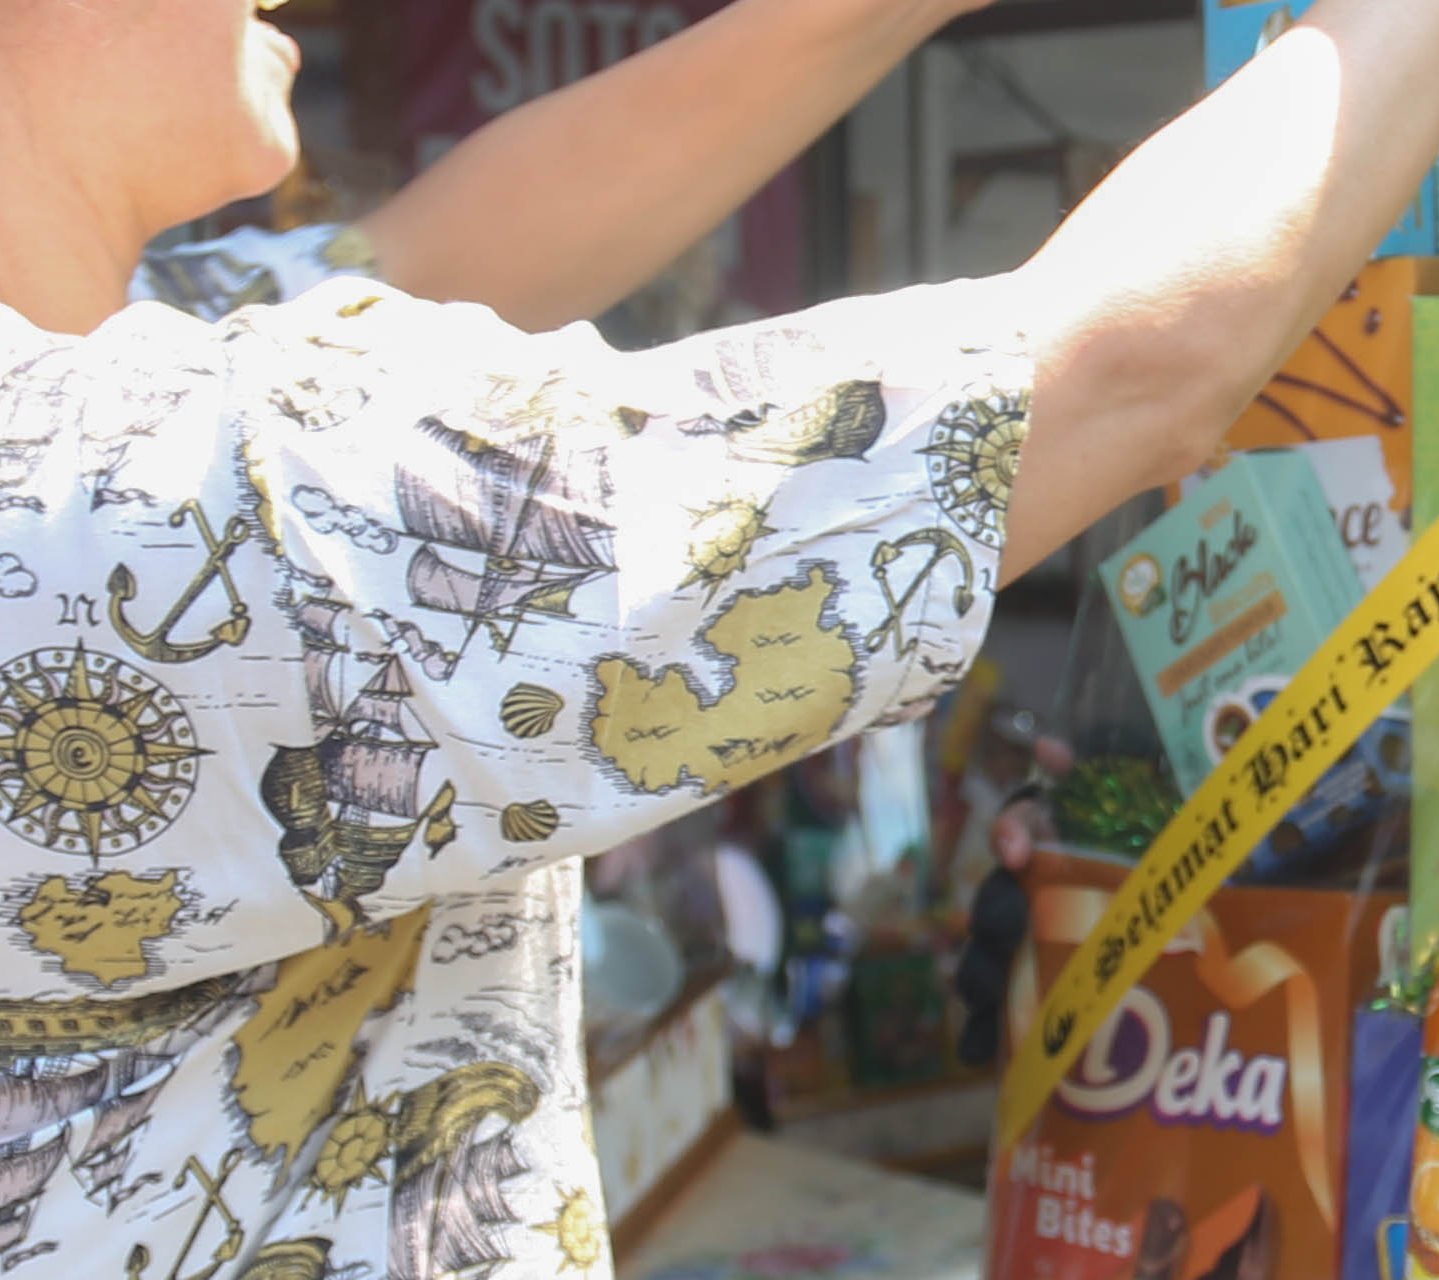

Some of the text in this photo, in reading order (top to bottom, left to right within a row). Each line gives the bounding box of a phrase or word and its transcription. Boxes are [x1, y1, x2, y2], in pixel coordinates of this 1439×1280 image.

[1243, 682, 1349, 811] Hari
[1058, 985, 1287, 1127] Deka
[1012, 1142, 1097, 1201] Mini
[1035, 1194, 1135, 1259] Bites
